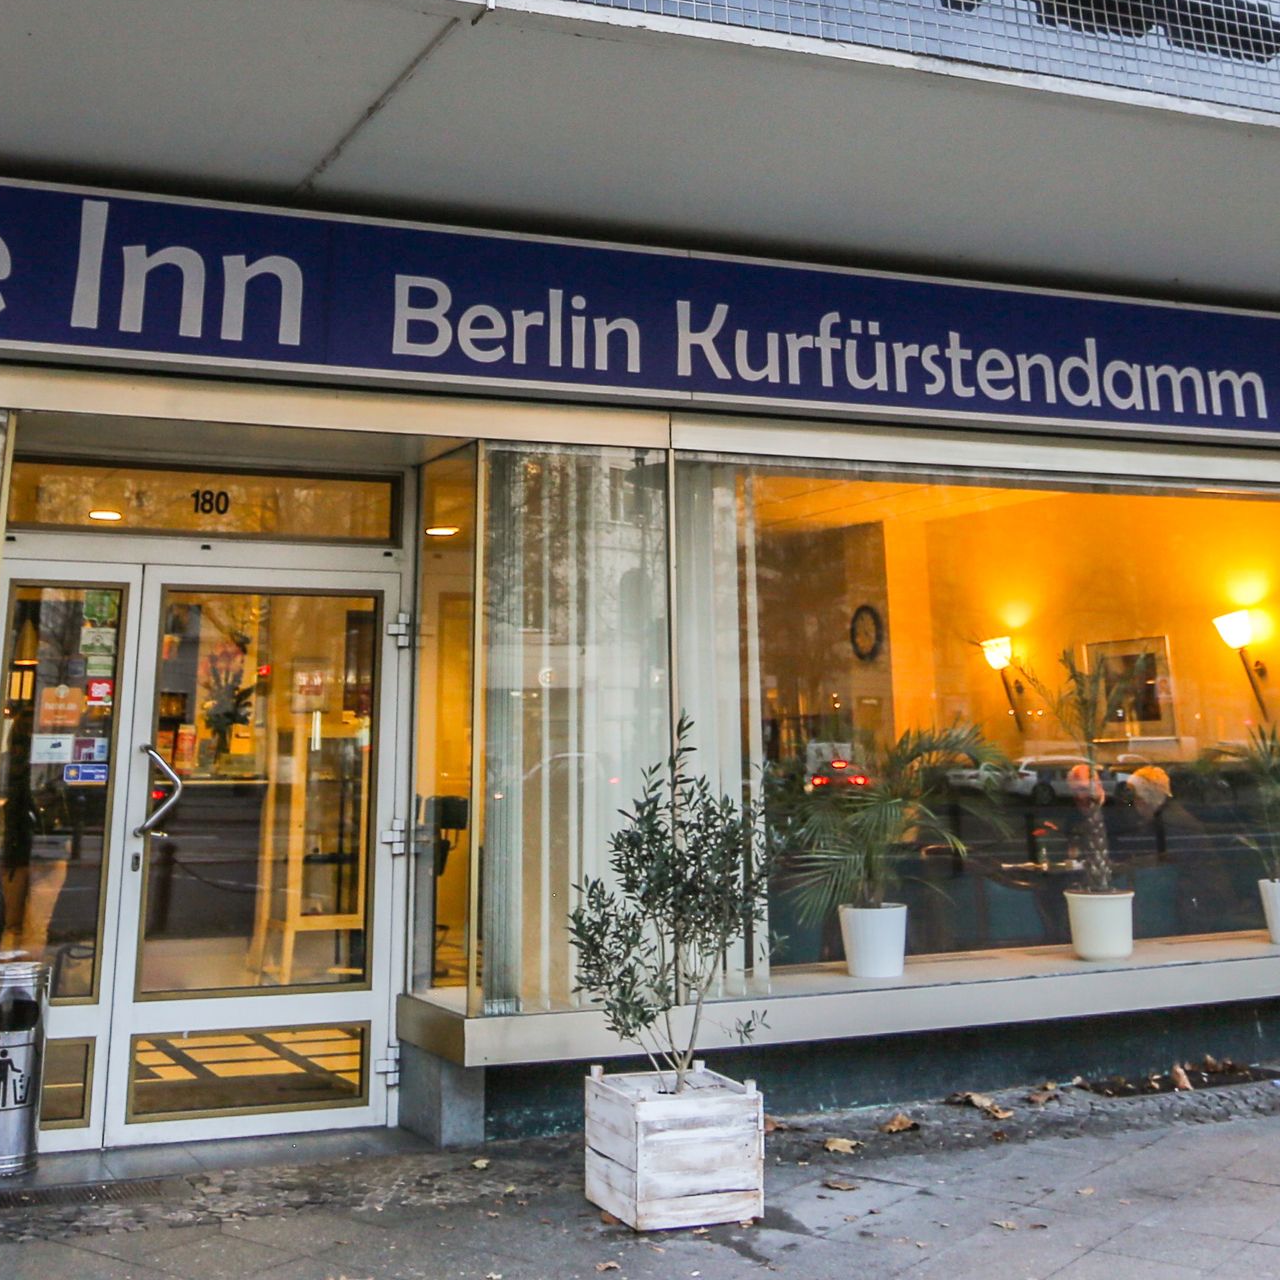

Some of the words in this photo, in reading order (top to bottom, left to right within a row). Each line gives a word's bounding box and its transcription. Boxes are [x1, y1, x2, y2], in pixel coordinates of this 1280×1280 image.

[69, 198, 304, 346] Inn
[391, 274, 641, 374] Berlin
[676, 299, 1269, 421] Kurfürstendamm
[191, 489, 230, 515] 180
